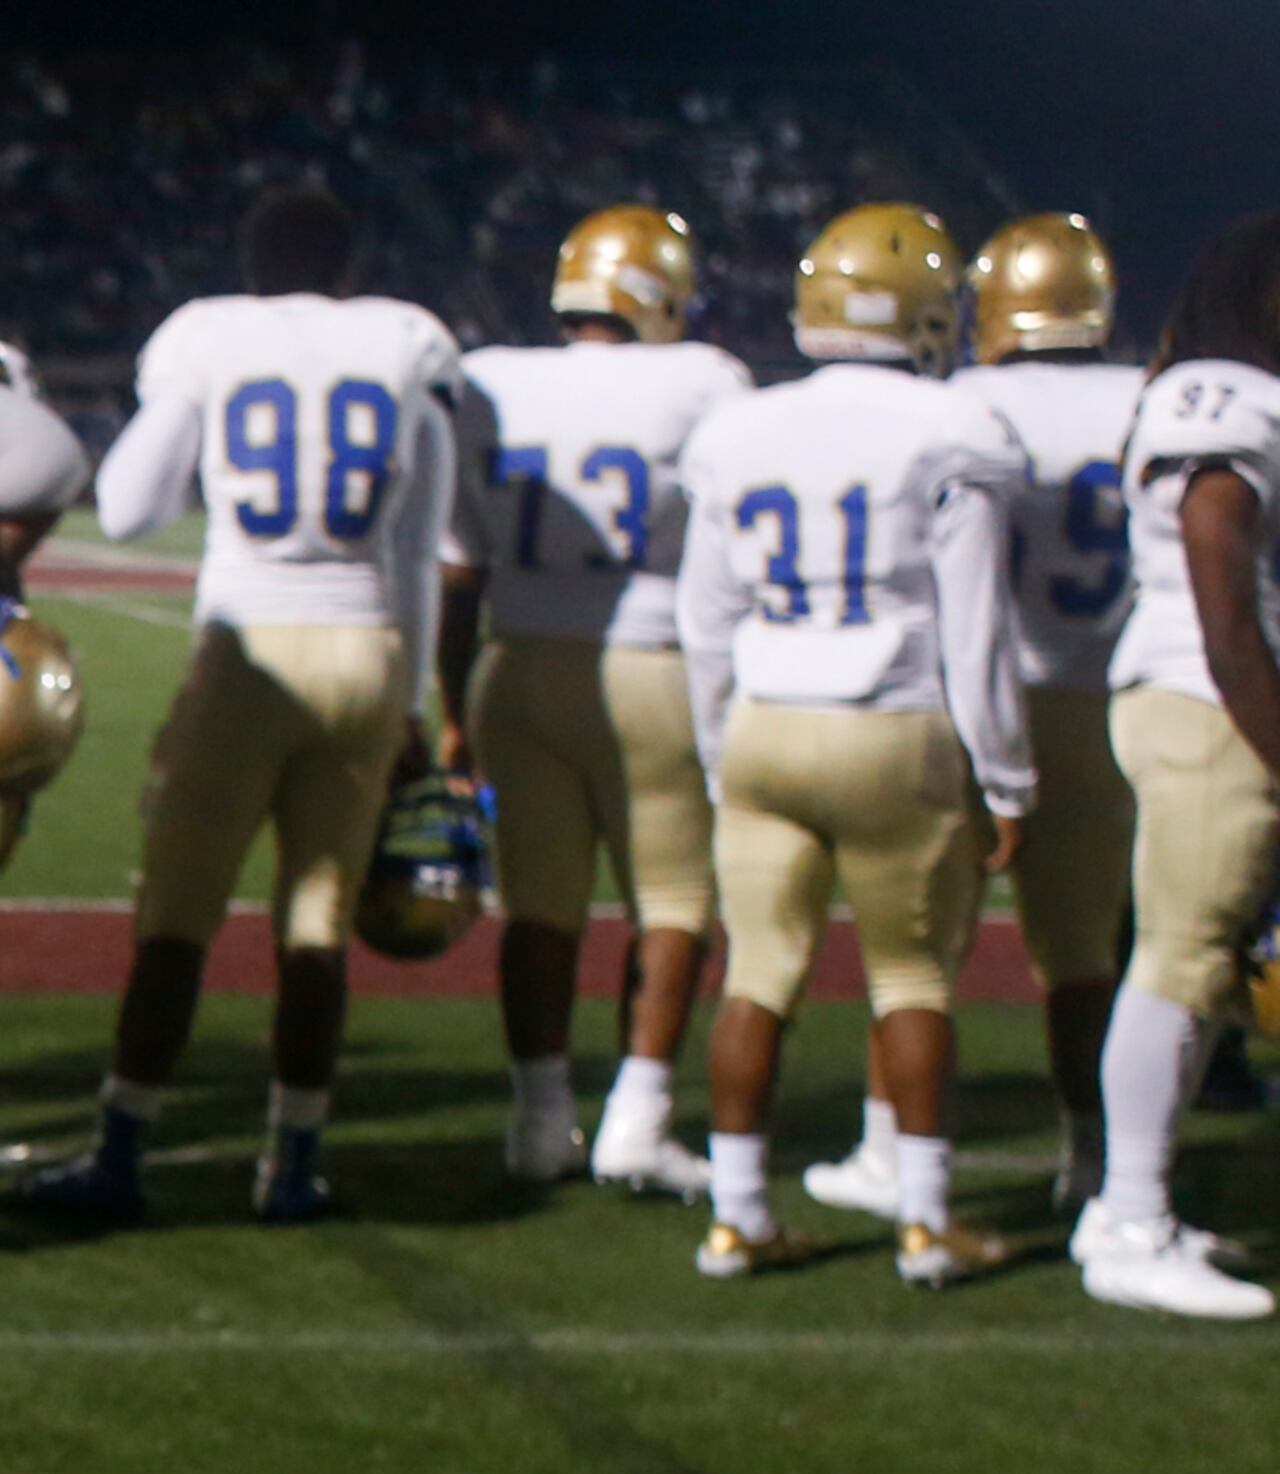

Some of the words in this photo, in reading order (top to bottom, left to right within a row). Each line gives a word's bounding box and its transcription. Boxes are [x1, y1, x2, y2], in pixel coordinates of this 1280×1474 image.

[224, 377, 403, 542] 98
[490, 443, 653, 572] 73
[735, 481, 874, 627] 31
